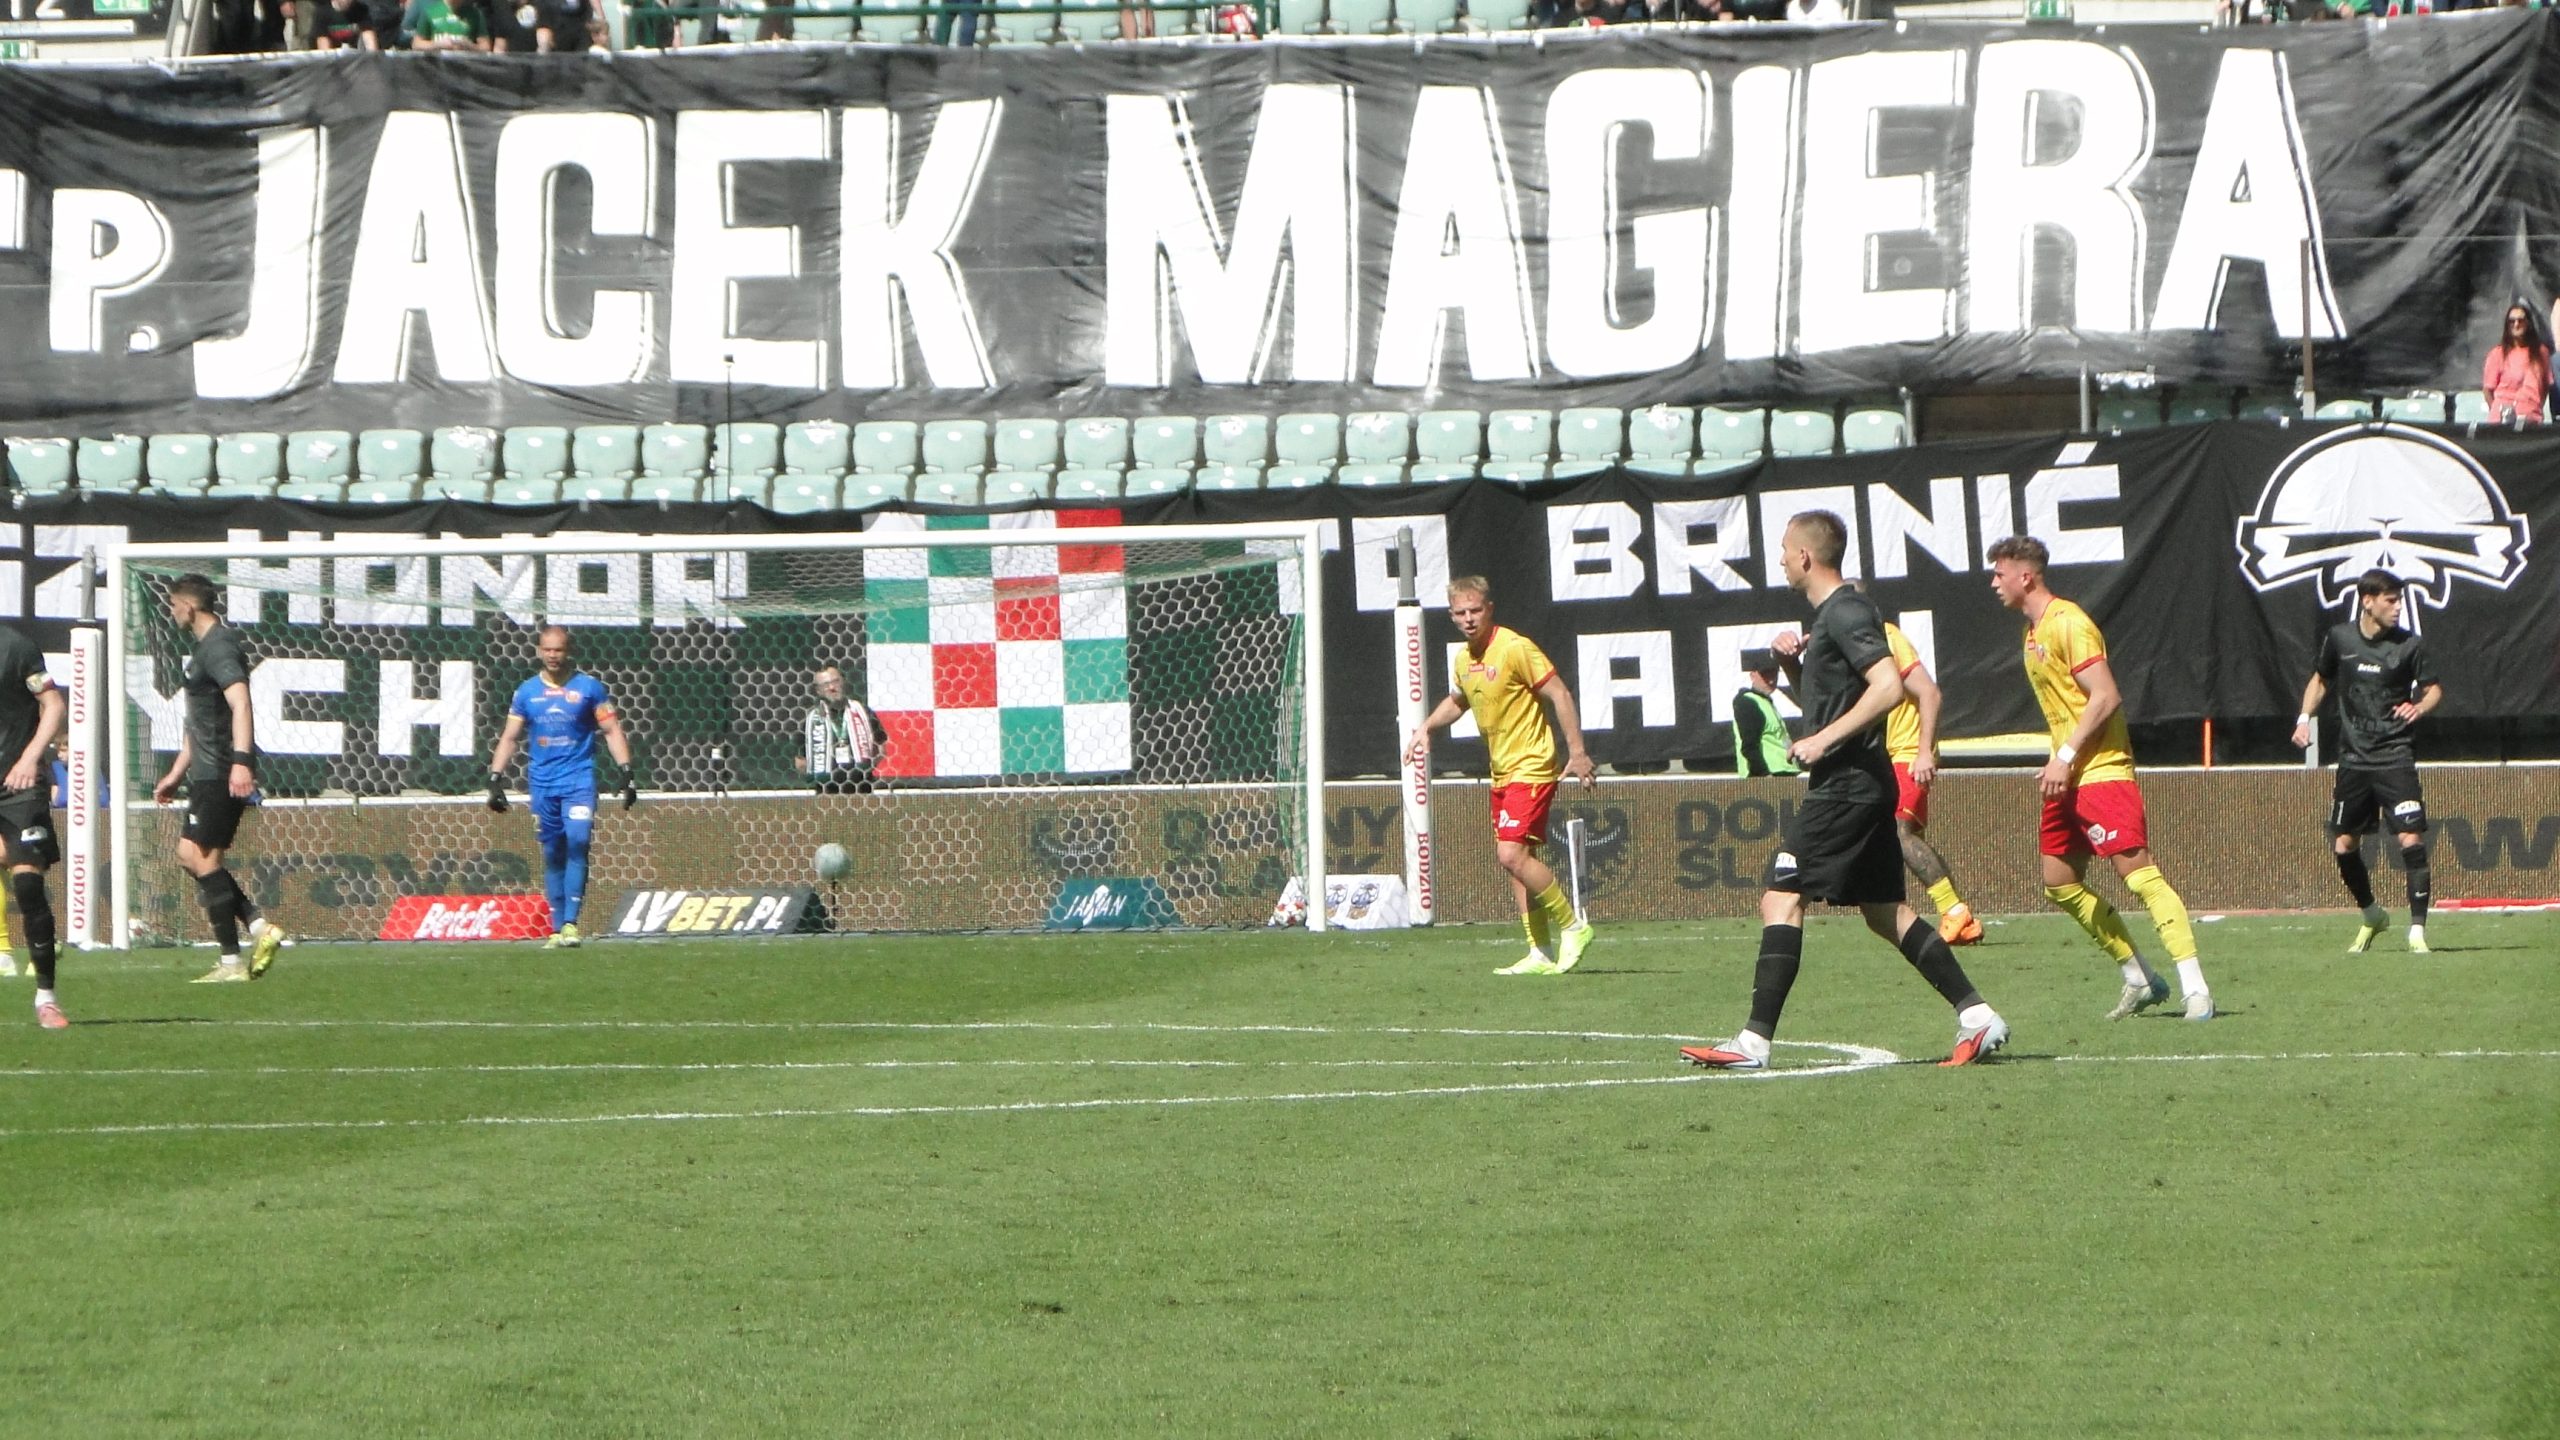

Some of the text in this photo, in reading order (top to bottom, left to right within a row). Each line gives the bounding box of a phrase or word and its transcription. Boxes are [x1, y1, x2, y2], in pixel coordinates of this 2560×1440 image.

[193, 97, 1002, 399] JACEK
[1105, 40, 2347, 388] MAGIERA
[0, 522, 129, 619] Z
[227, 527, 748, 628] HONOR
[1548, 441, 2125, 604] BRONIĆ
[72, 647, 86, 725] BODZIO
[1406, 625, 1423, 703] BODZIO
[42, 650, 475, 758] YCH
[72, 749, 86, 827] BODZIO
[1411, 728, 1428, 806] ODZIO
[72, 852, 86, 930] BODZIO
[1416, 832, 1433, 911] BODZIO
[413, 899, 503, 938] Betclic
[617, 891, 792, 933] LVBET.PL
